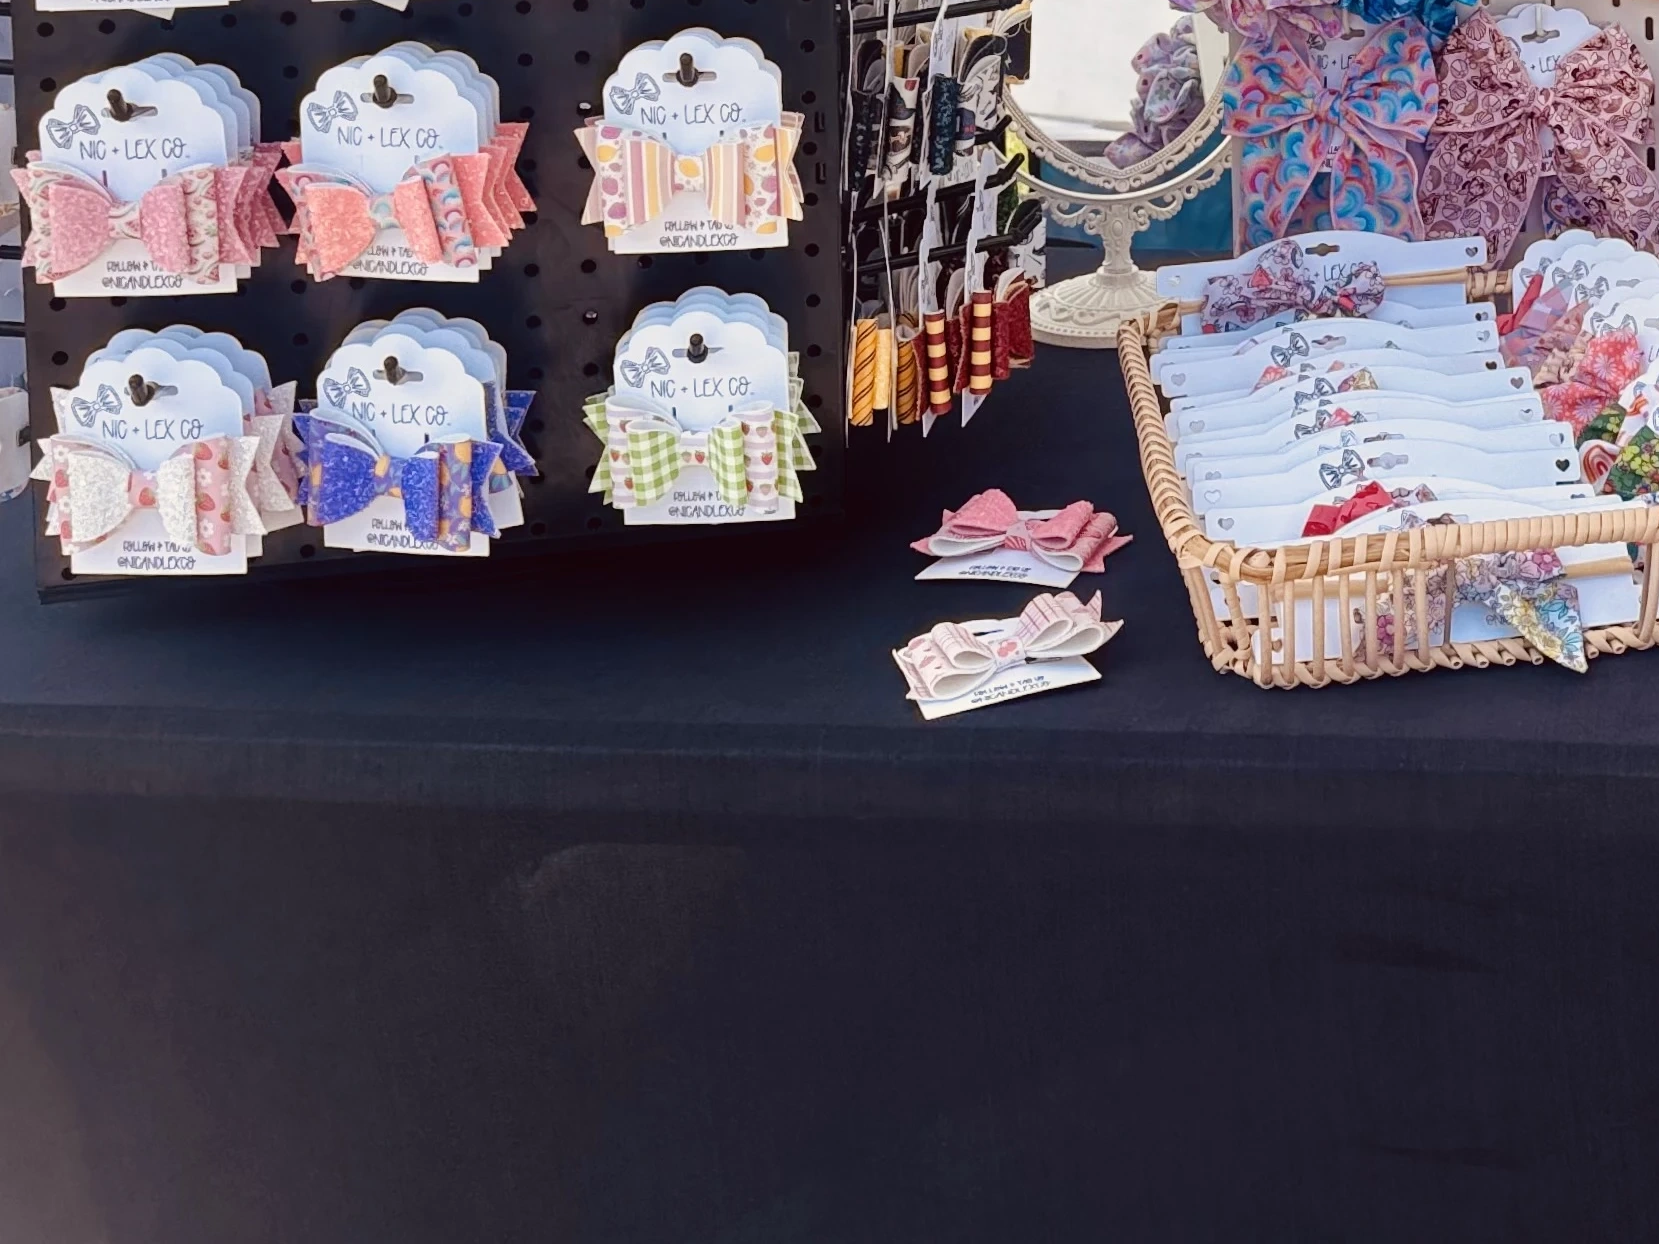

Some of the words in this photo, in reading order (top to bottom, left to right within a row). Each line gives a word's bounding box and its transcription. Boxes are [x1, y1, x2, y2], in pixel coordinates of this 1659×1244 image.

[641, 106, 666, 125] NIC
[684, 104, 715, 124] LEX
[338, 126, 362, 146] NIC
[380, 127, 410, 148] LEX
[80, 140, 105, 159] NIC
[125, 138, 157, 160] LEX
[651, 379, 675, 398] NIC
[693, 377, 724, 397] LEX
[392, 404, 421, 425] LEX
[102, 420, 127, 440] NIC
[145, 419, 175, 440] LEX
